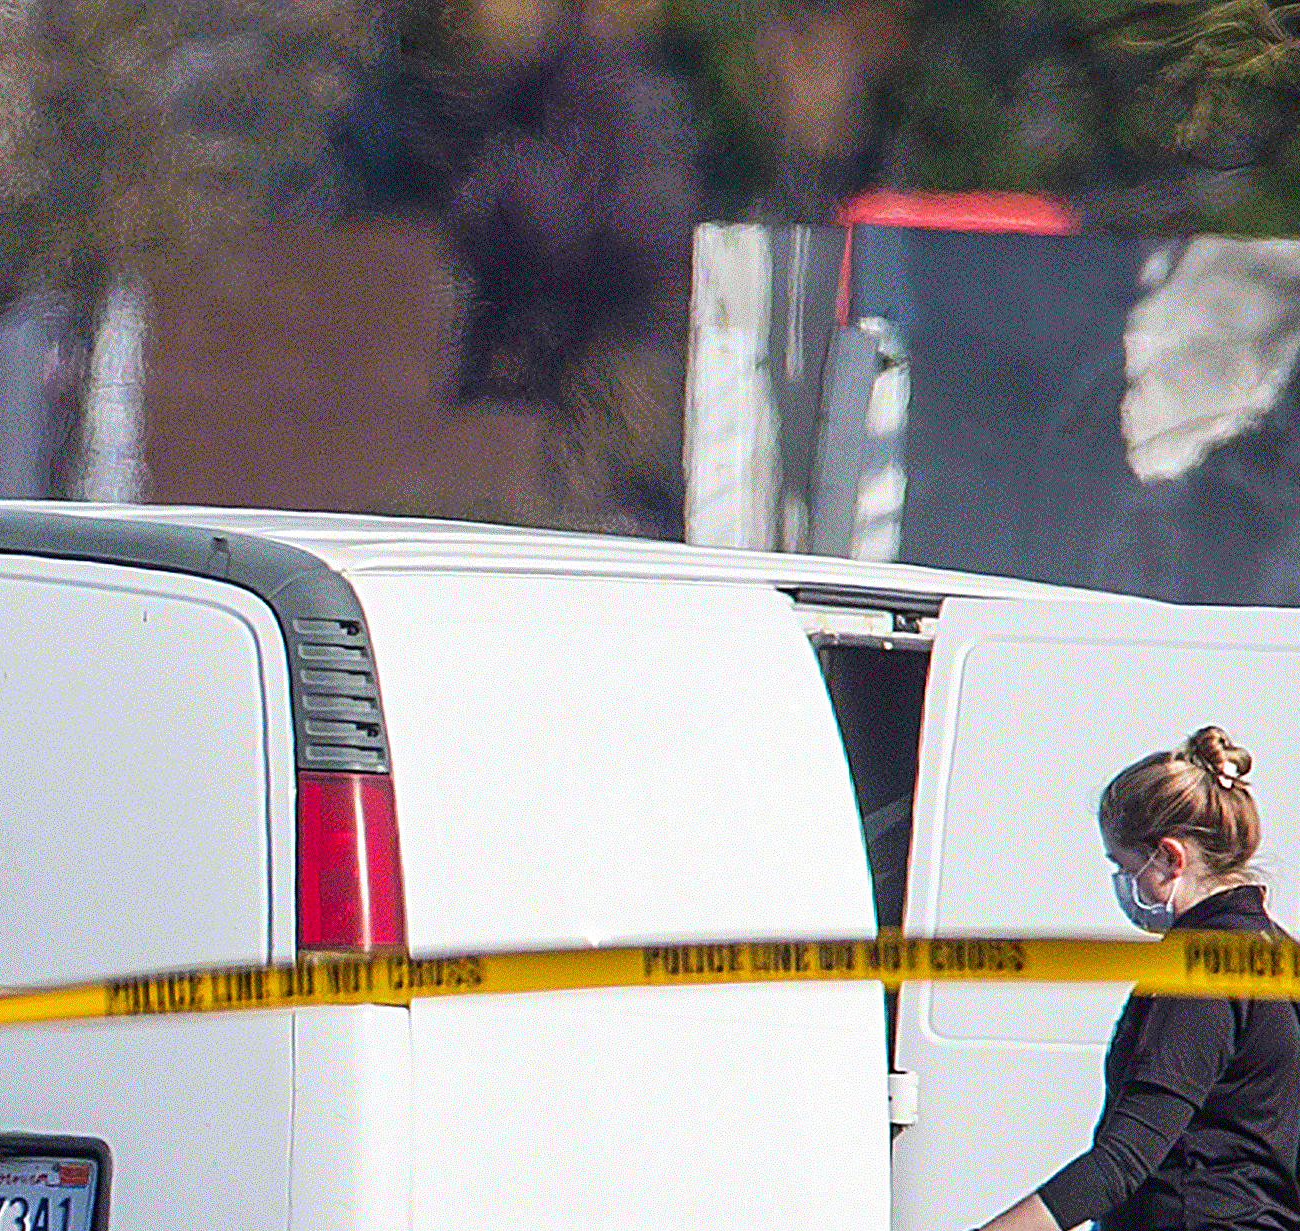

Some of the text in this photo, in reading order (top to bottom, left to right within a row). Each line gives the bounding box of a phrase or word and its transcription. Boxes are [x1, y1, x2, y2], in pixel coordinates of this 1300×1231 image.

[643, 938, 1024, 977] POLICE LINE DO NOT CROSS
[1184, 938, 1283, 977] POLICE
[106, 973, 202, 1014] POLICE
[387, 953, 482, 989] CROSS
